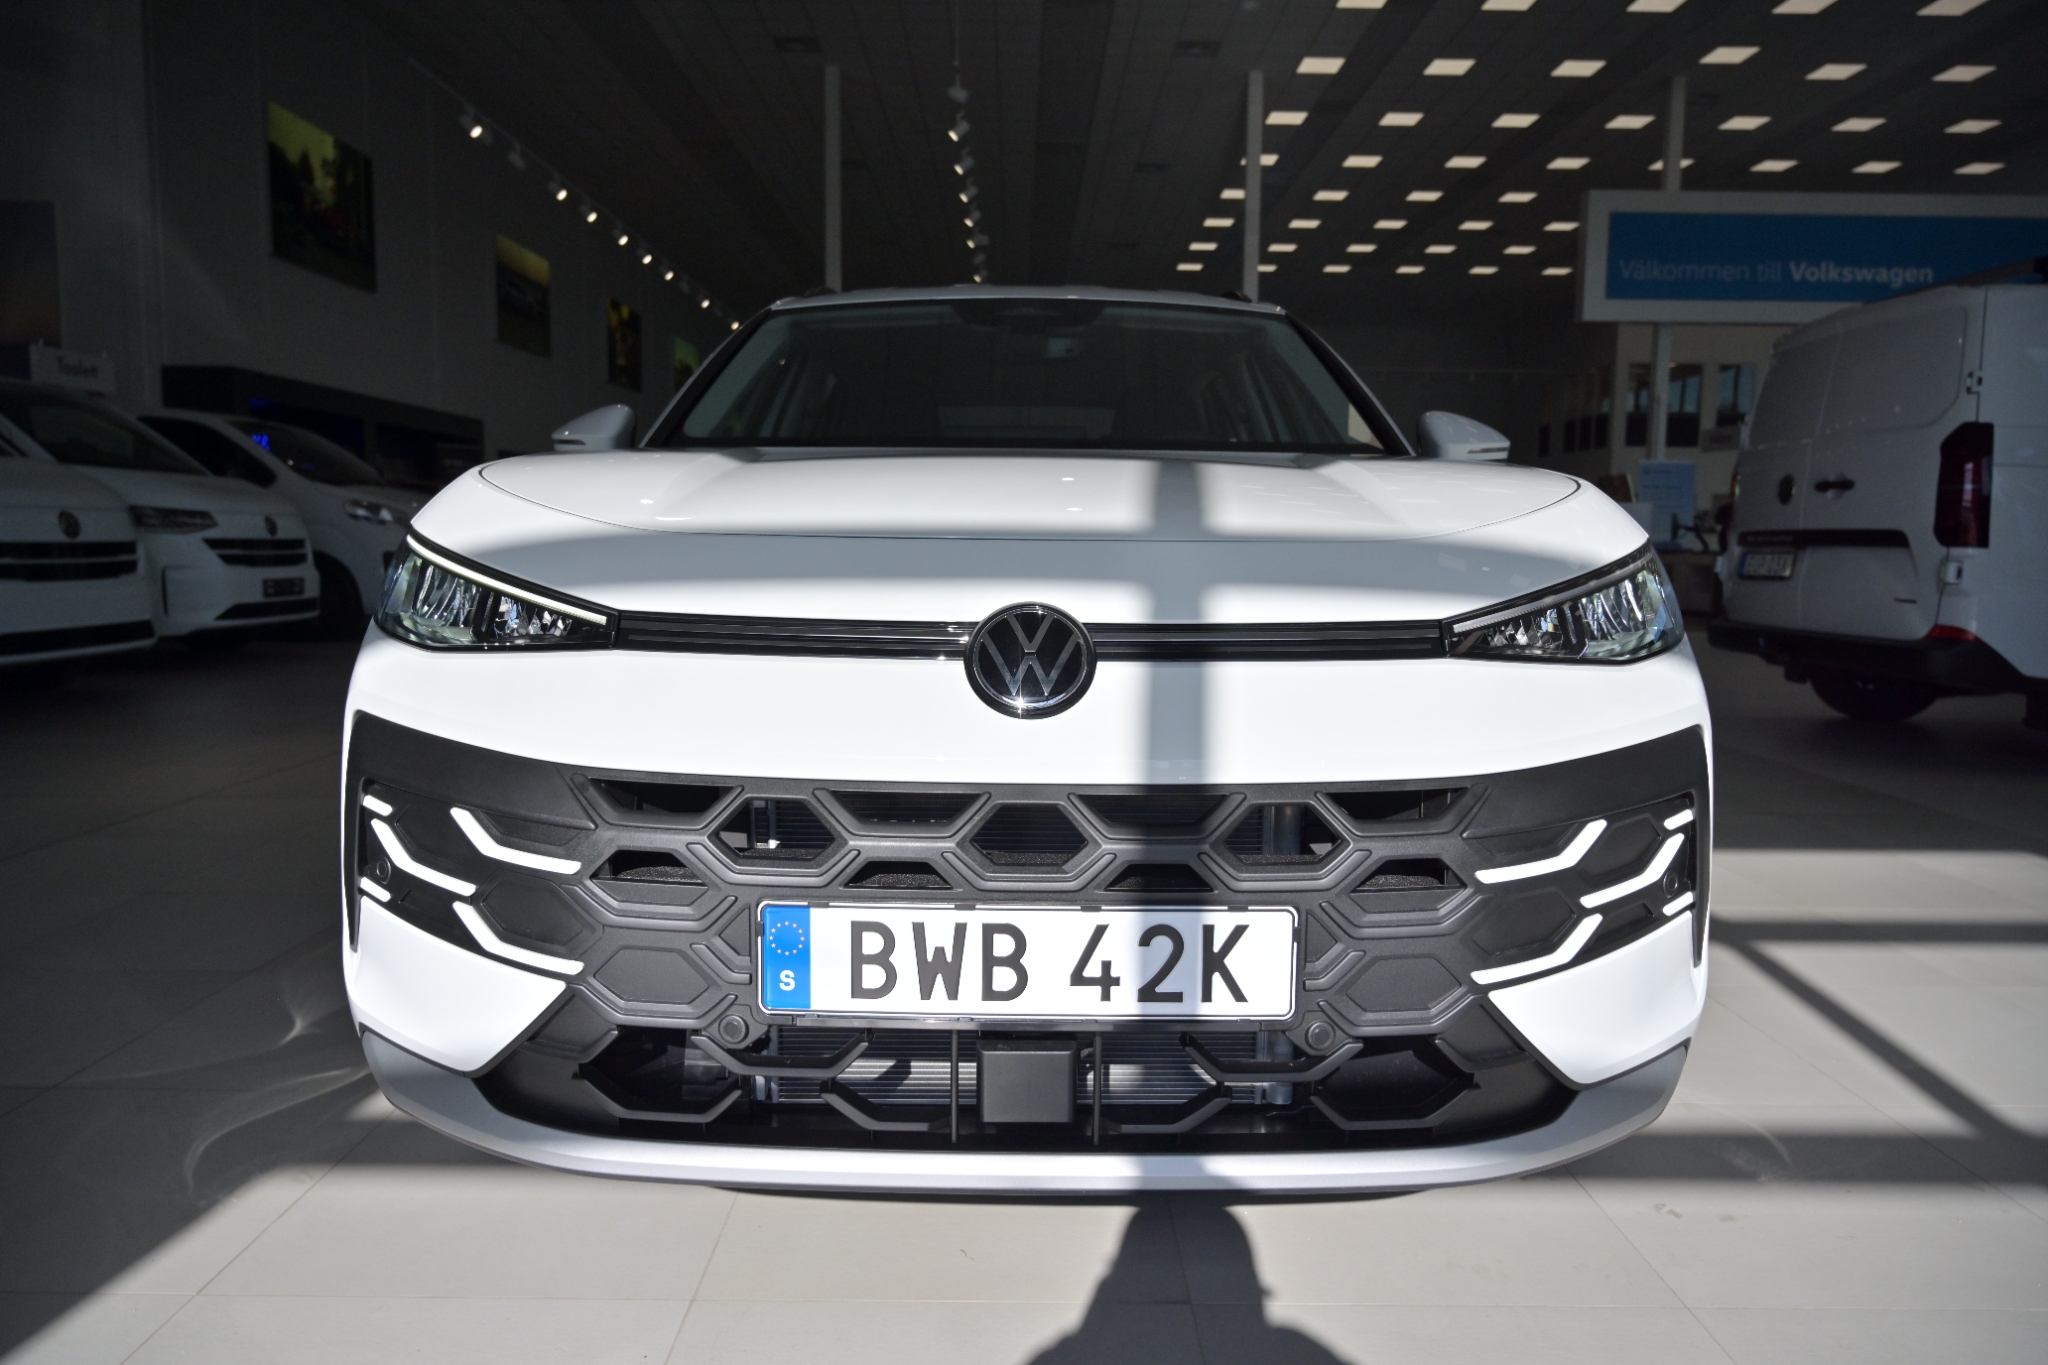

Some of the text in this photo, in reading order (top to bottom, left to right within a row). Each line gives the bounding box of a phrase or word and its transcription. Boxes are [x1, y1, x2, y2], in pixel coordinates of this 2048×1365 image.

[1619, 258, 1934, 289] Välkommen till Volkswagen
[974, 607, 1086, 700] VW
[778, 969, 796, 991] S
[850, 920, 1250, 1003] BWB 42K
